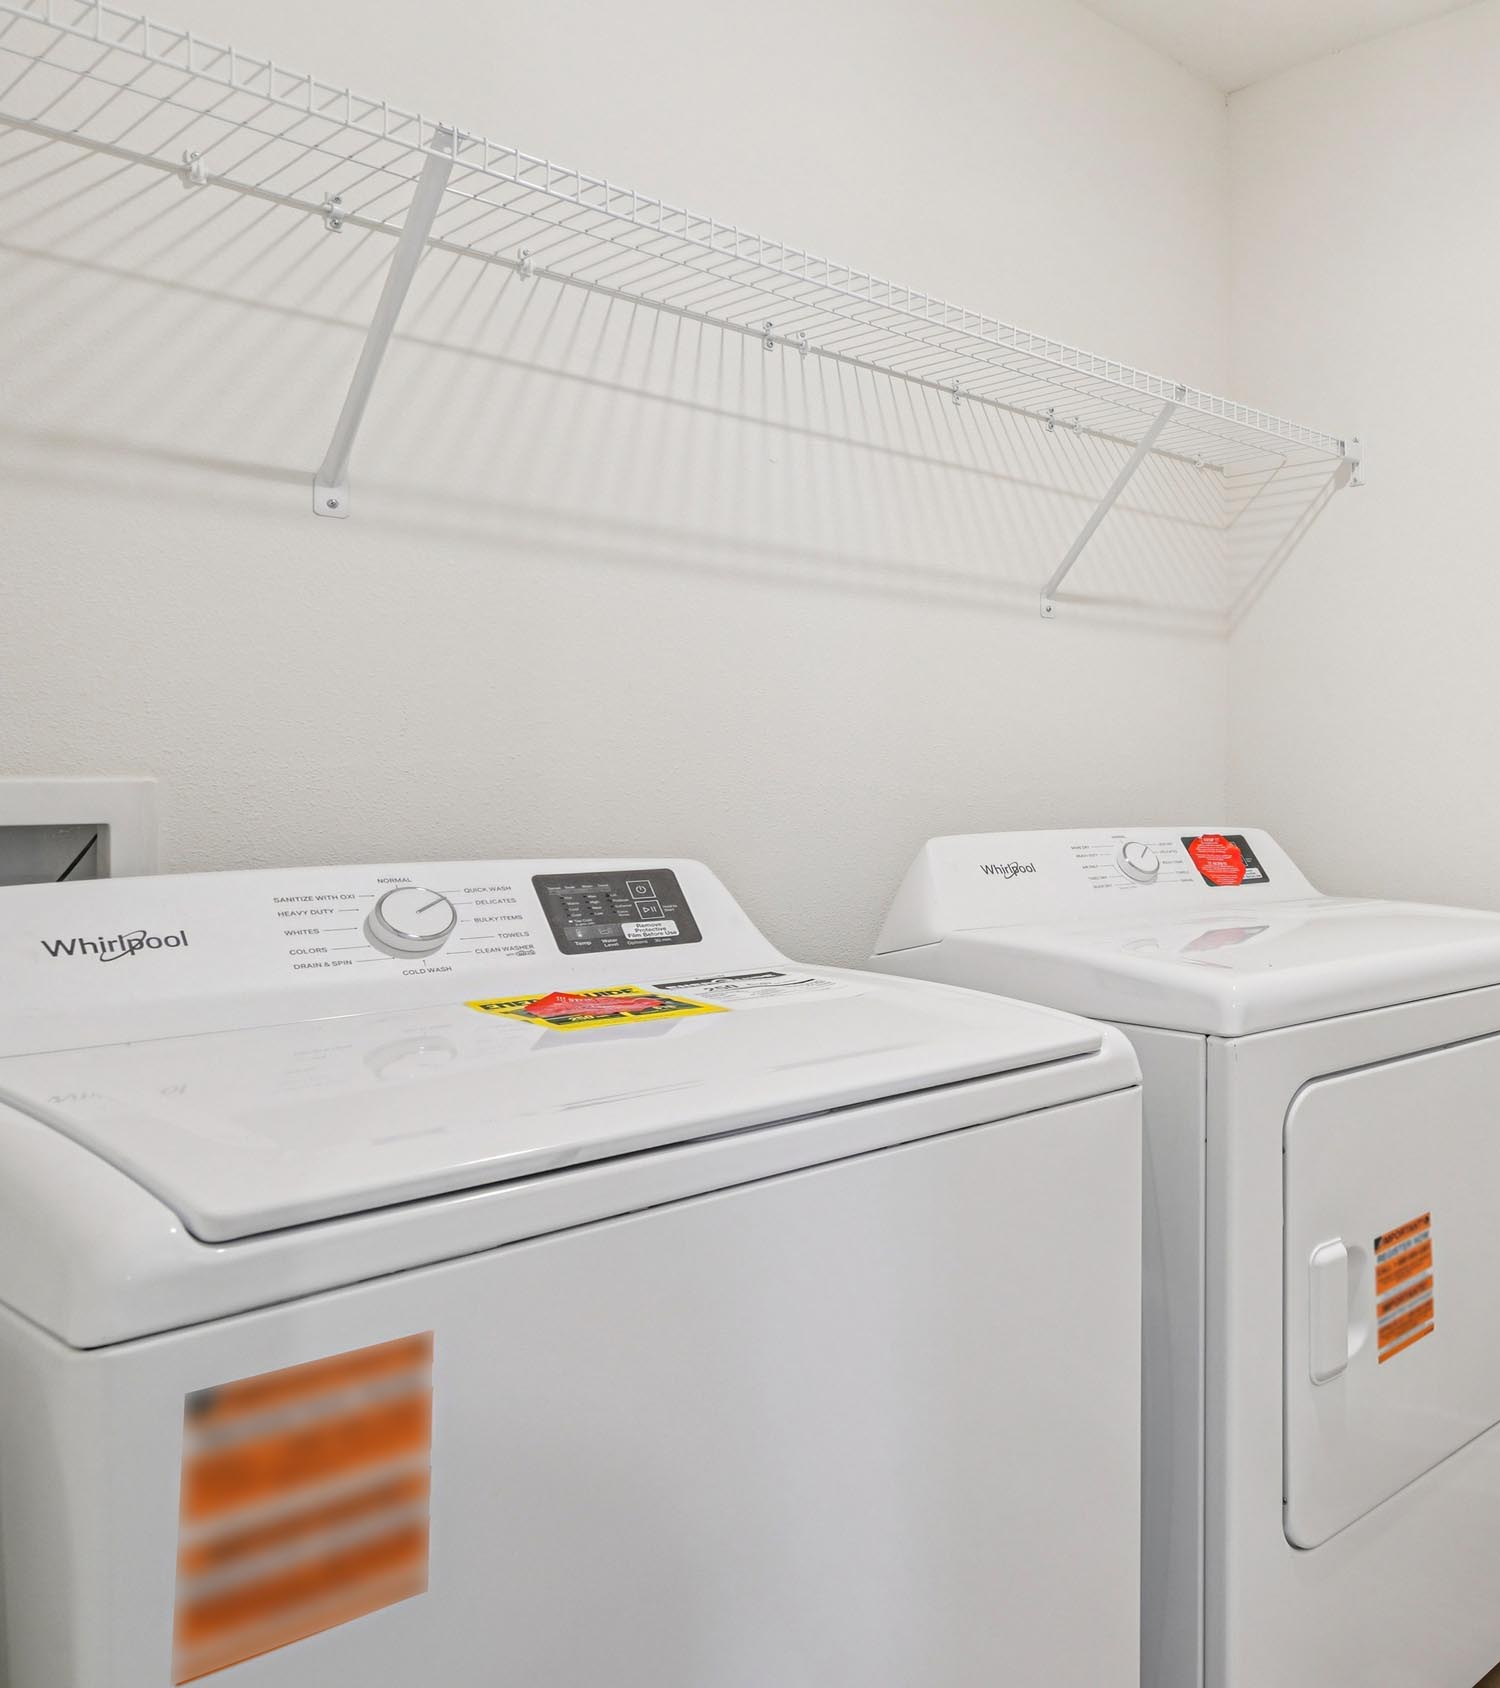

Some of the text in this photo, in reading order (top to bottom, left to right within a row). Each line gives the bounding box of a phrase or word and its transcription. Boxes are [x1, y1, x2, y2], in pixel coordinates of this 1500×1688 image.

[979, 861, 1037, 880] Whirlpool
[463, 885, 512, 894] QUICK WASH
[273, 893, 356, 904] SANITIZE WITH OXI
[474, 897, 517, 905] DELICATES
[277, 907, 335, 918] HEAVY DUTY
[283, 928, 320, 936] WHITES
[41, 929, 189, 961] Whirlpool
[501, 944, 535, 952] WASHER
[288, 946, 329, 956] COLORS
[293, 961, 322, 970] DRAIN
[331, 959, 353, 967] SPIN
[402, 966, 453, 976] COLD WASH
